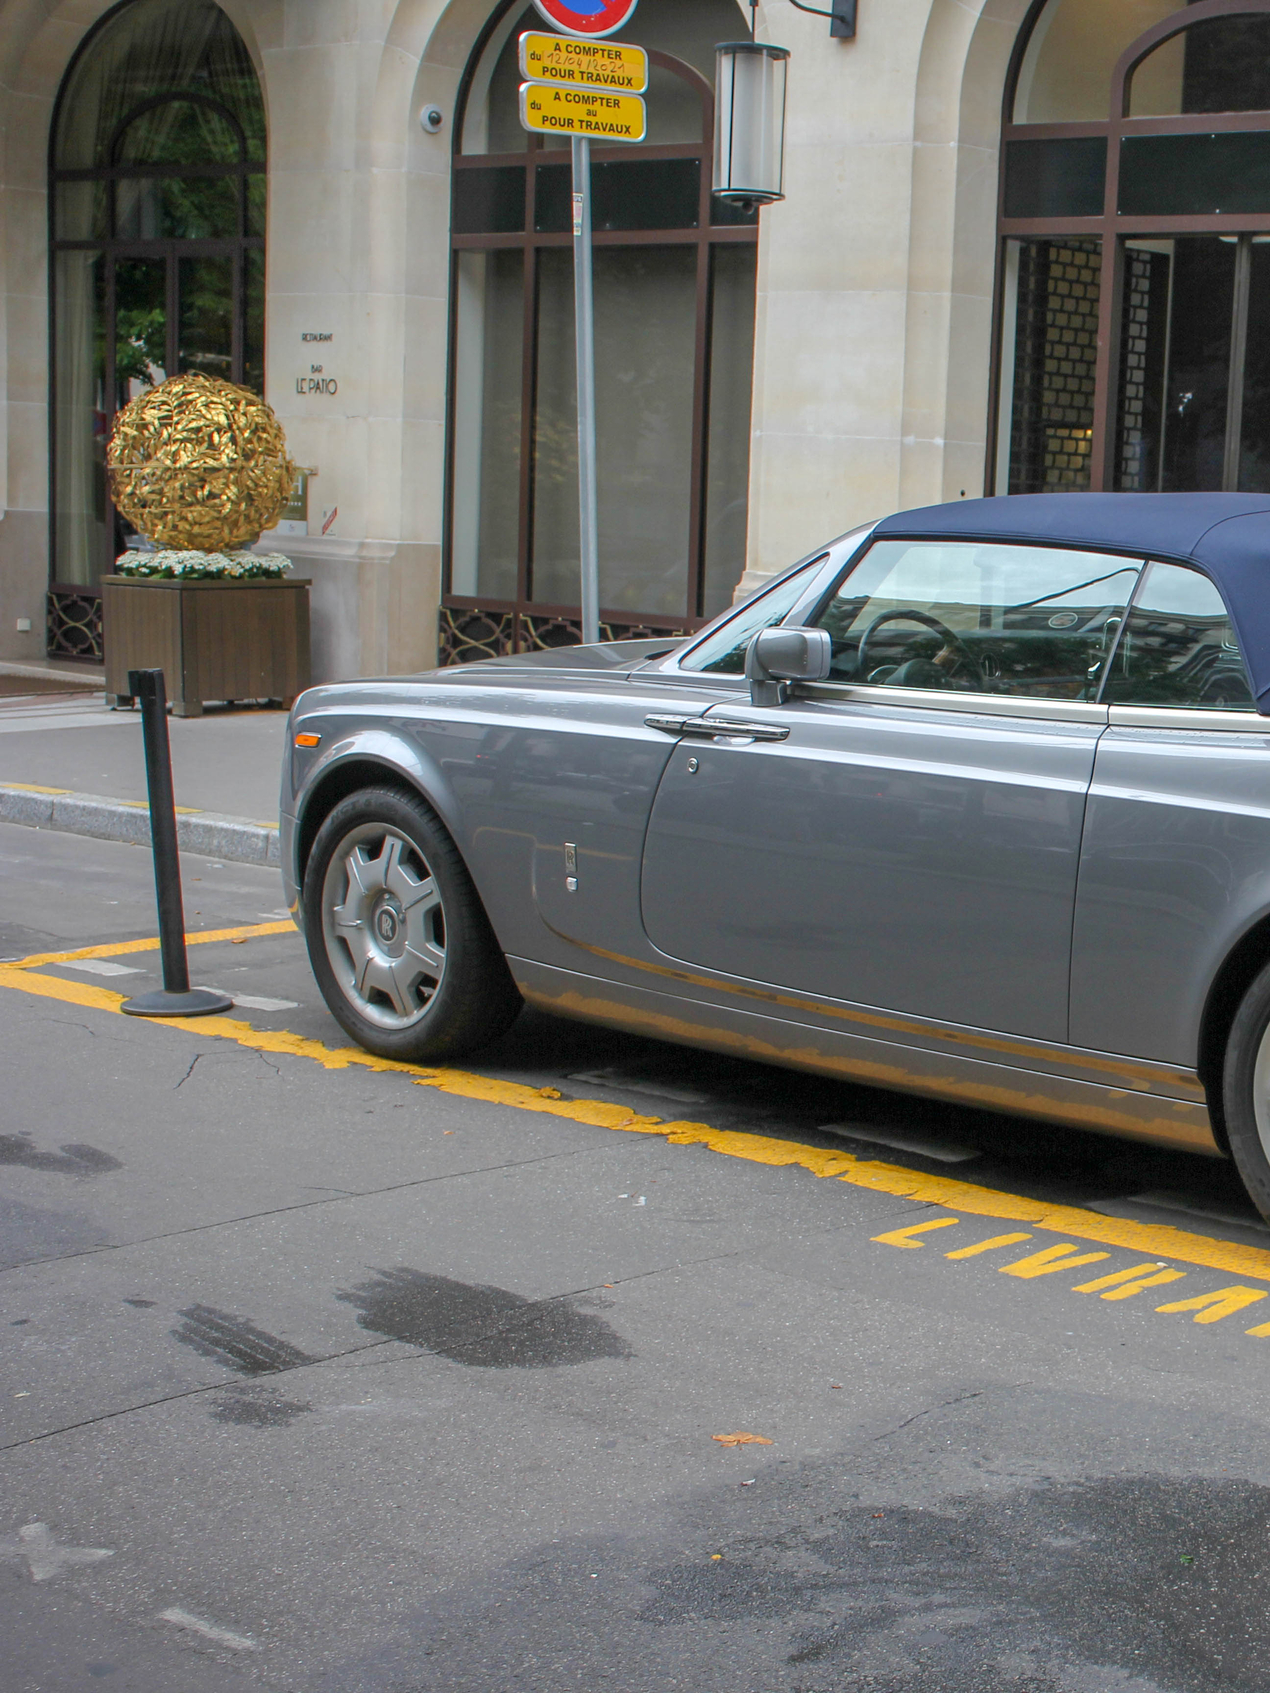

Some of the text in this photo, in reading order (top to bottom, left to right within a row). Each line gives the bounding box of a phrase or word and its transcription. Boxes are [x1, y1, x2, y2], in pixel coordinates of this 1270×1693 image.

[530, 51, 542, 61] du
[554, 43, 622, 60] A COMPTER
[542, 66, 633, 87] POUR TRAVAUX
[530, 100, 597, 117] du au
[553, 91, 621, 109] A COMPTER
[542, 115, 632, 135] POUR TRAVAUX
[311, 364, 323, 373] BAR
[296, 378, 338, 395] LE PATIO
